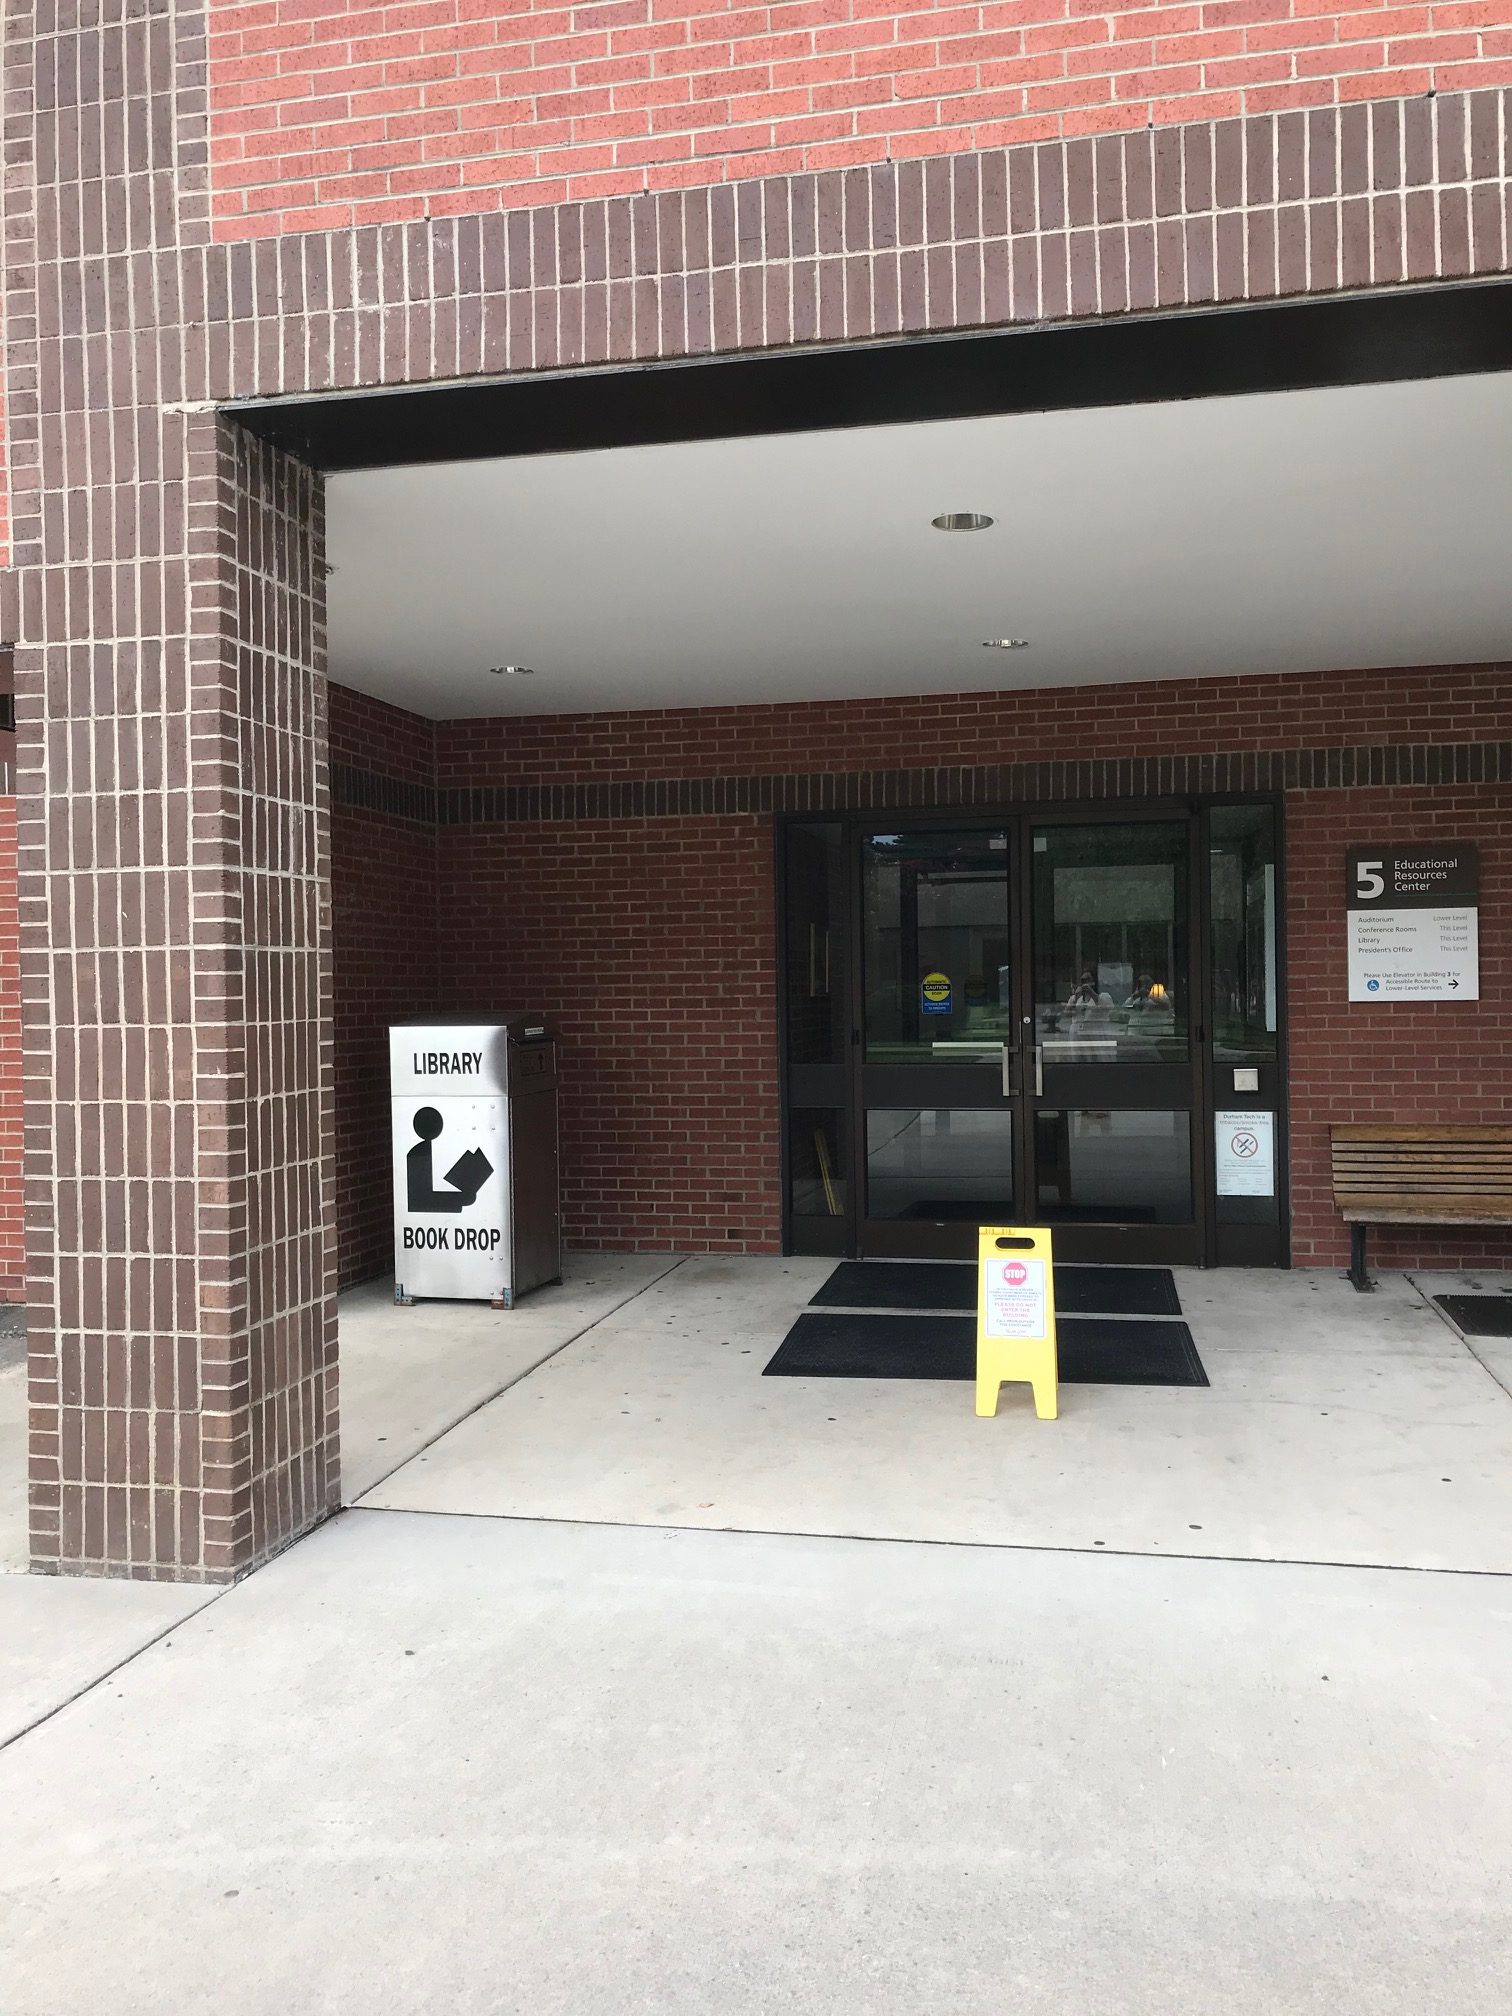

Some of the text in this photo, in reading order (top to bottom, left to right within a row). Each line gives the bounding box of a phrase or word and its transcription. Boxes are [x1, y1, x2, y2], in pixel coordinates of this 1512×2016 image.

[1394, 858, 1458, 870] Educational
[1357, 861, 1385, 899] 5
[1394, 870, 1447, 880] Resources
[1394, 882, 1431, 891] Center
[414, 1052, 483, 1075] LIBRARY
[403, 1227, 501, 1251] BOOK DROP
[1004, 1269, 1026, 1279] STOP
